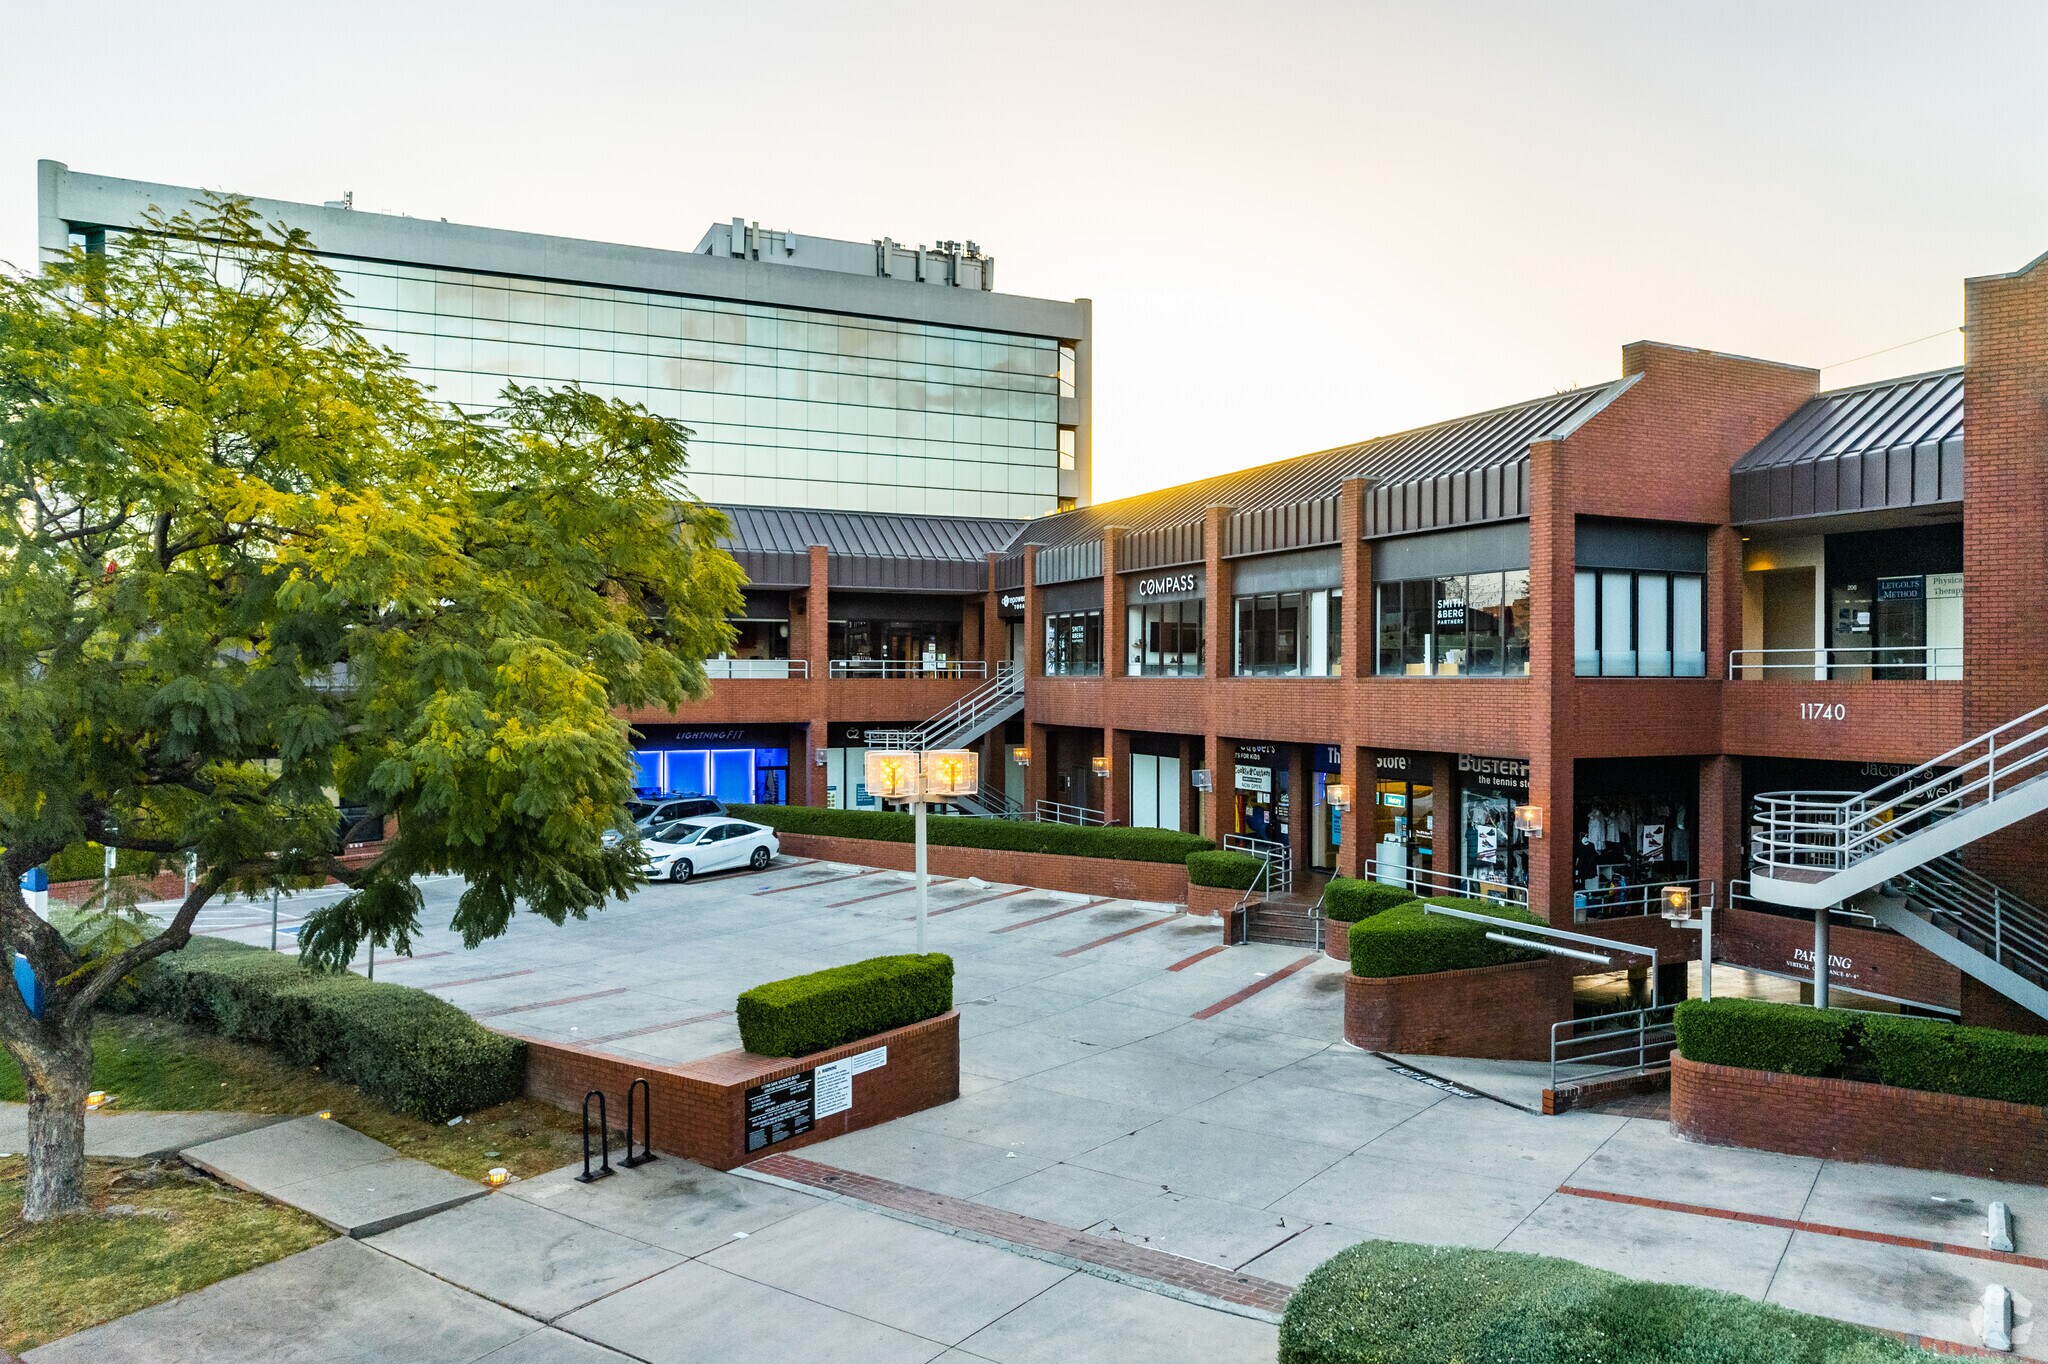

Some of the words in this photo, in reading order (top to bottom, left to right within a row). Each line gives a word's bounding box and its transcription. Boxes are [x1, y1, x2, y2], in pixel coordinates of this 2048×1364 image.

[1139, 574, 1195, 596] COMPASS
[1883, 590, 1918, 598] METHOD
[1437, 598, 1464, 609] SMITH
[1437, 609, 1464, 618] &BERG
[1800, 703, 1846, 721] 11740
[1478, 775, 1491, 785] the
[1493, 776, 1518, 787] tennis
[1793, 948, 1852, 969] PARING
[1786, 960, 1810, 970] VERTICAL
